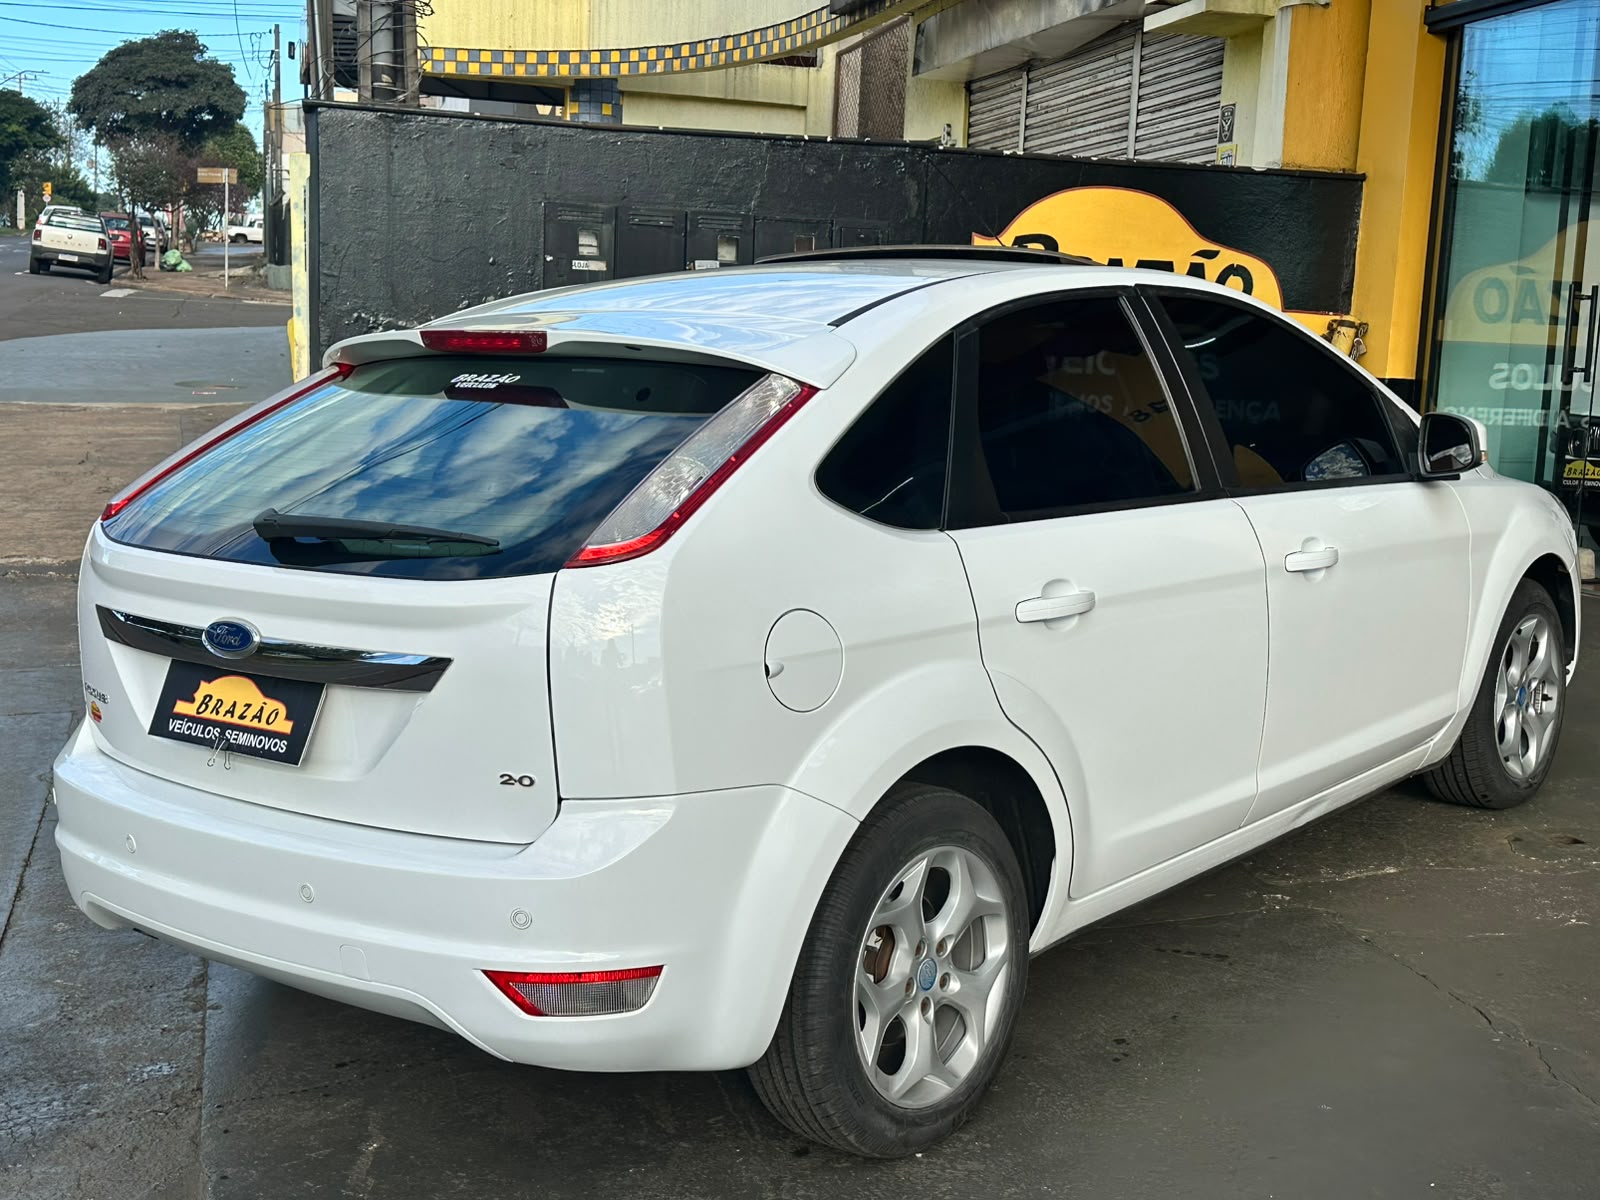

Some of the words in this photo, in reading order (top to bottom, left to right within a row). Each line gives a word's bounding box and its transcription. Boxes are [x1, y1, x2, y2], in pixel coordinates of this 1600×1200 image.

[209, 624, 243, 647] Ford
[196, 694, 280, 726] BRAZÃO
[168, 718, 221, 740] VEÍCULOS
[225, 729, 288, 753] SEMINOVOS
